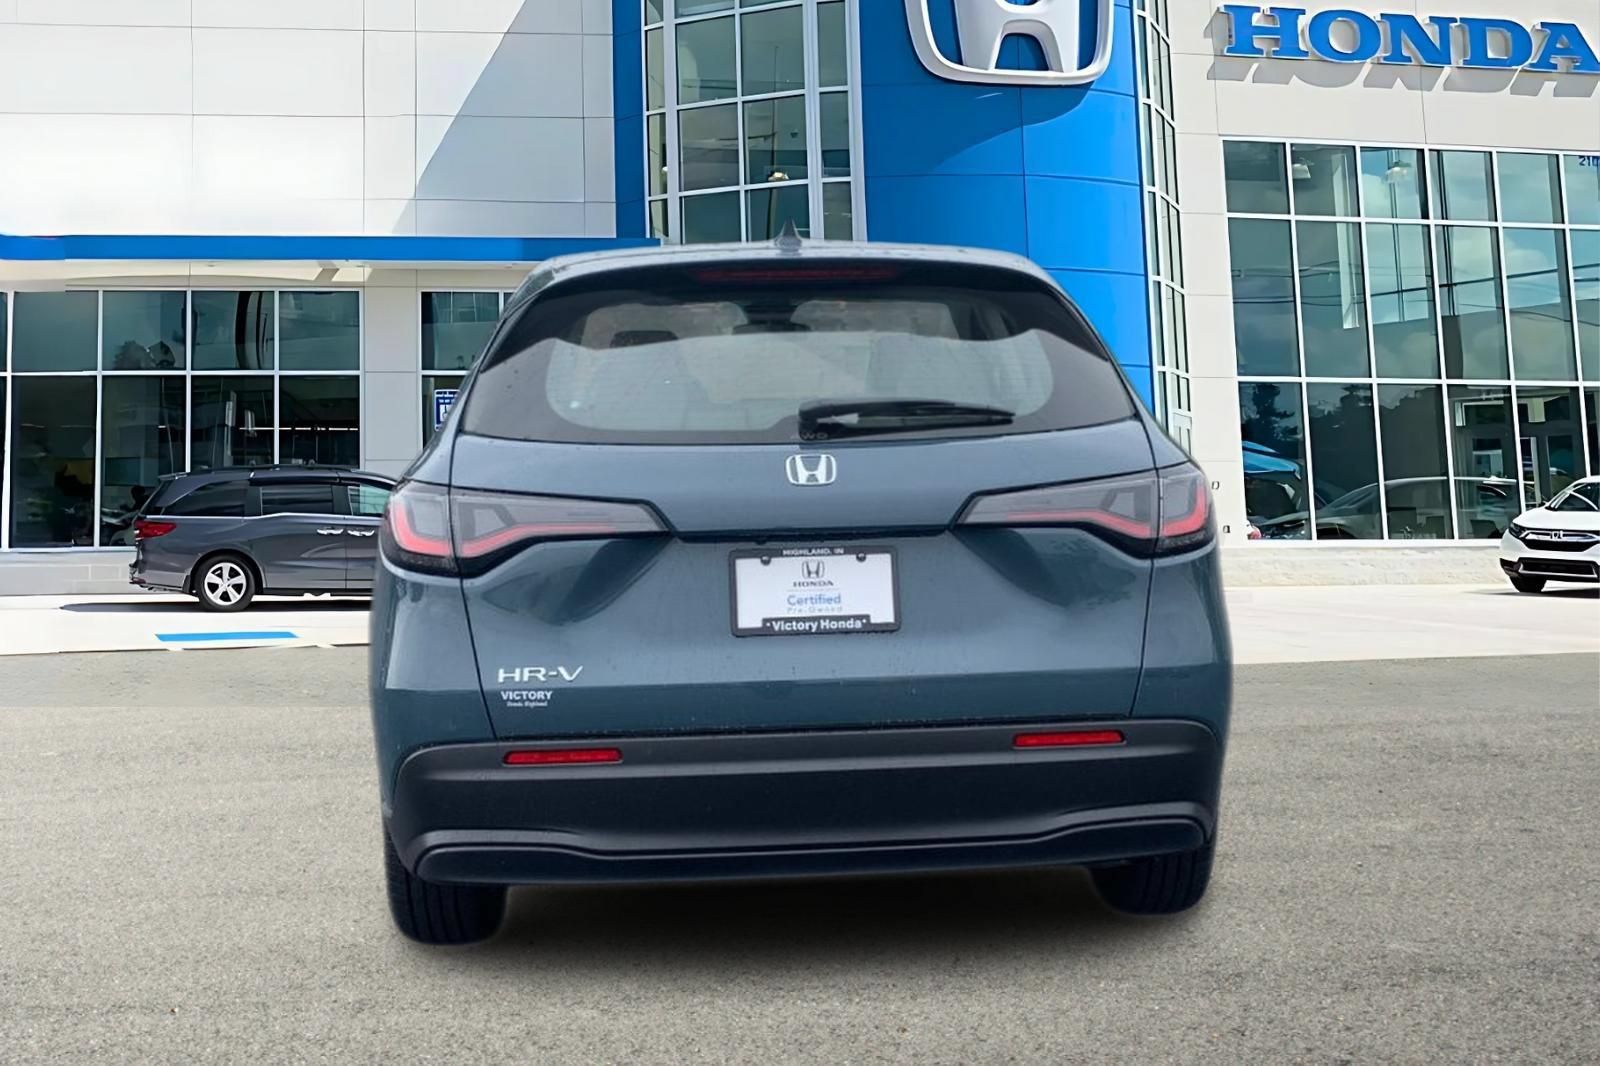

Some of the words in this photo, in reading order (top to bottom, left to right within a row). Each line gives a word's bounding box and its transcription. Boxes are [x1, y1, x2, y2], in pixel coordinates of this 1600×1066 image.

[1223, 4, 1600, 74] HONDA
[793, 580, 834, 588] HONDA
[787, 593, 842, 606] Certified
[772, 620, 818, 633] Victory
[820, 617, 862, 630] Honda
[498, 665, 584, 683] HR-V
[500, 690, 553, 700] VICTORY
